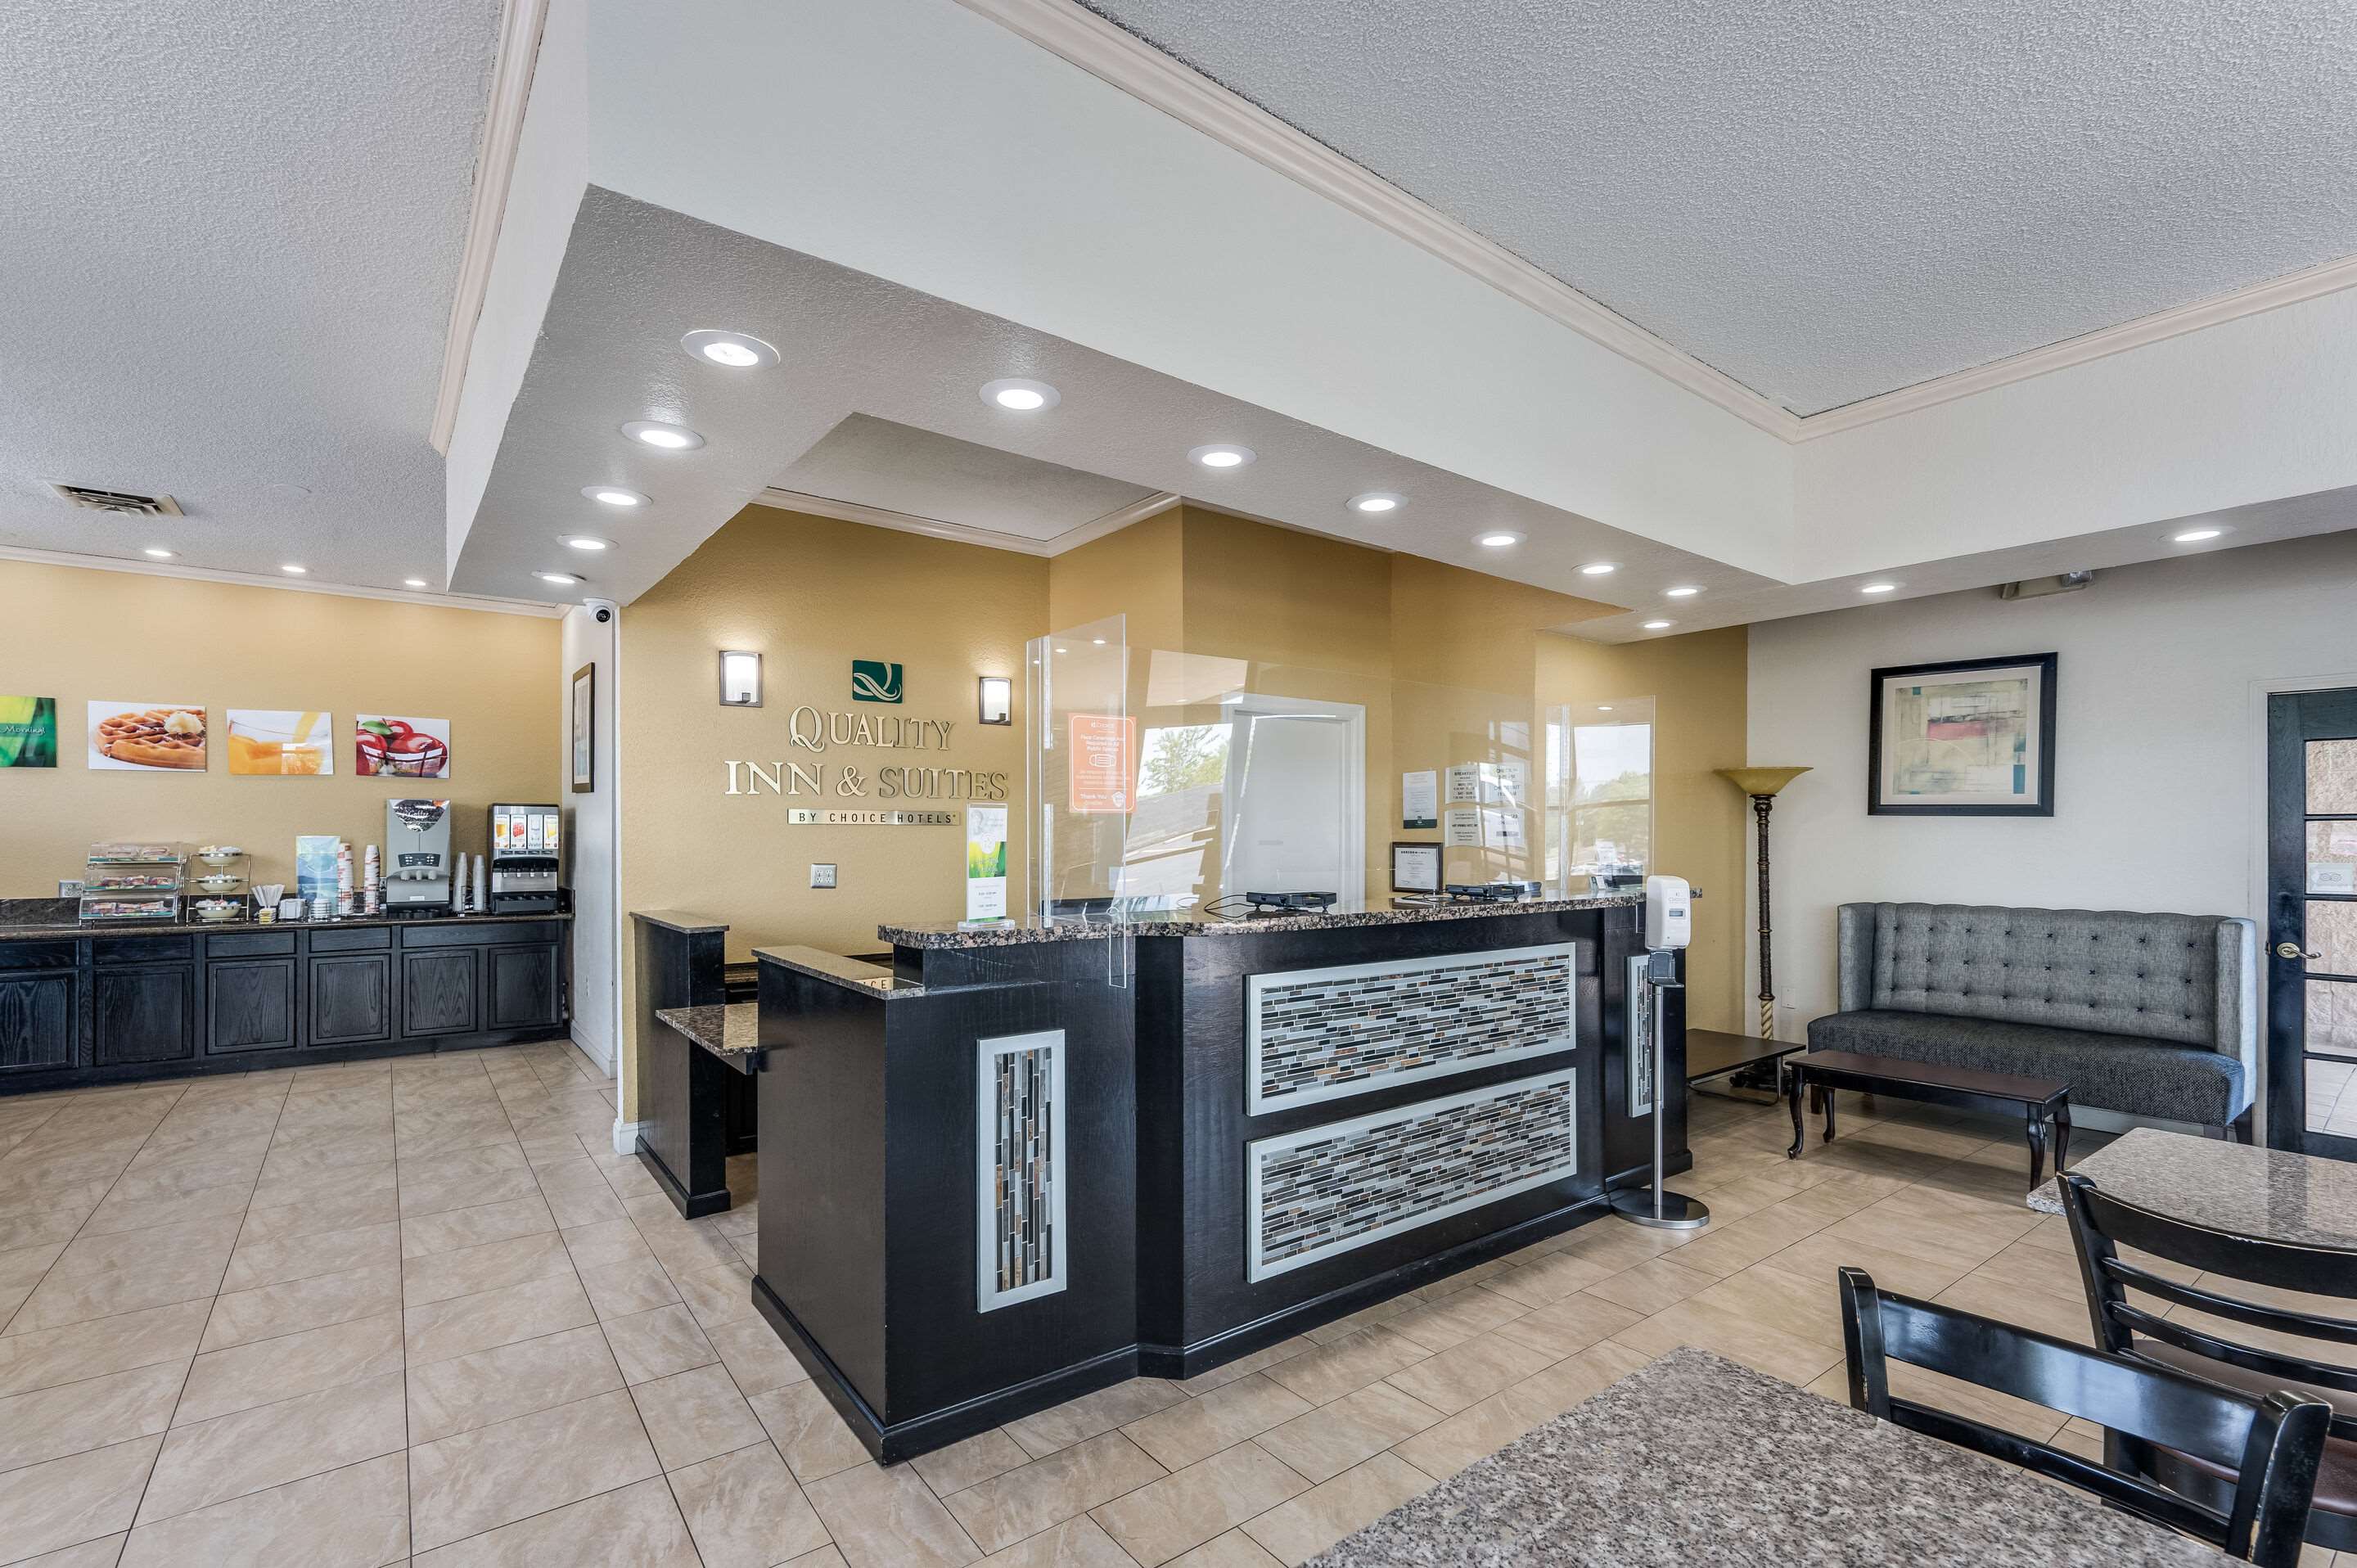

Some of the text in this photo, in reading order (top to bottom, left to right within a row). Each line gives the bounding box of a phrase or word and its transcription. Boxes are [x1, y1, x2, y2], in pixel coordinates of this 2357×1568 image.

[789, 705, 956, 753] QUALITY
[723, 760, 1009, 800] INN & SUITES
[799, 813, 817, 822] BY
[829, 813, 886, 823] CHOICE
